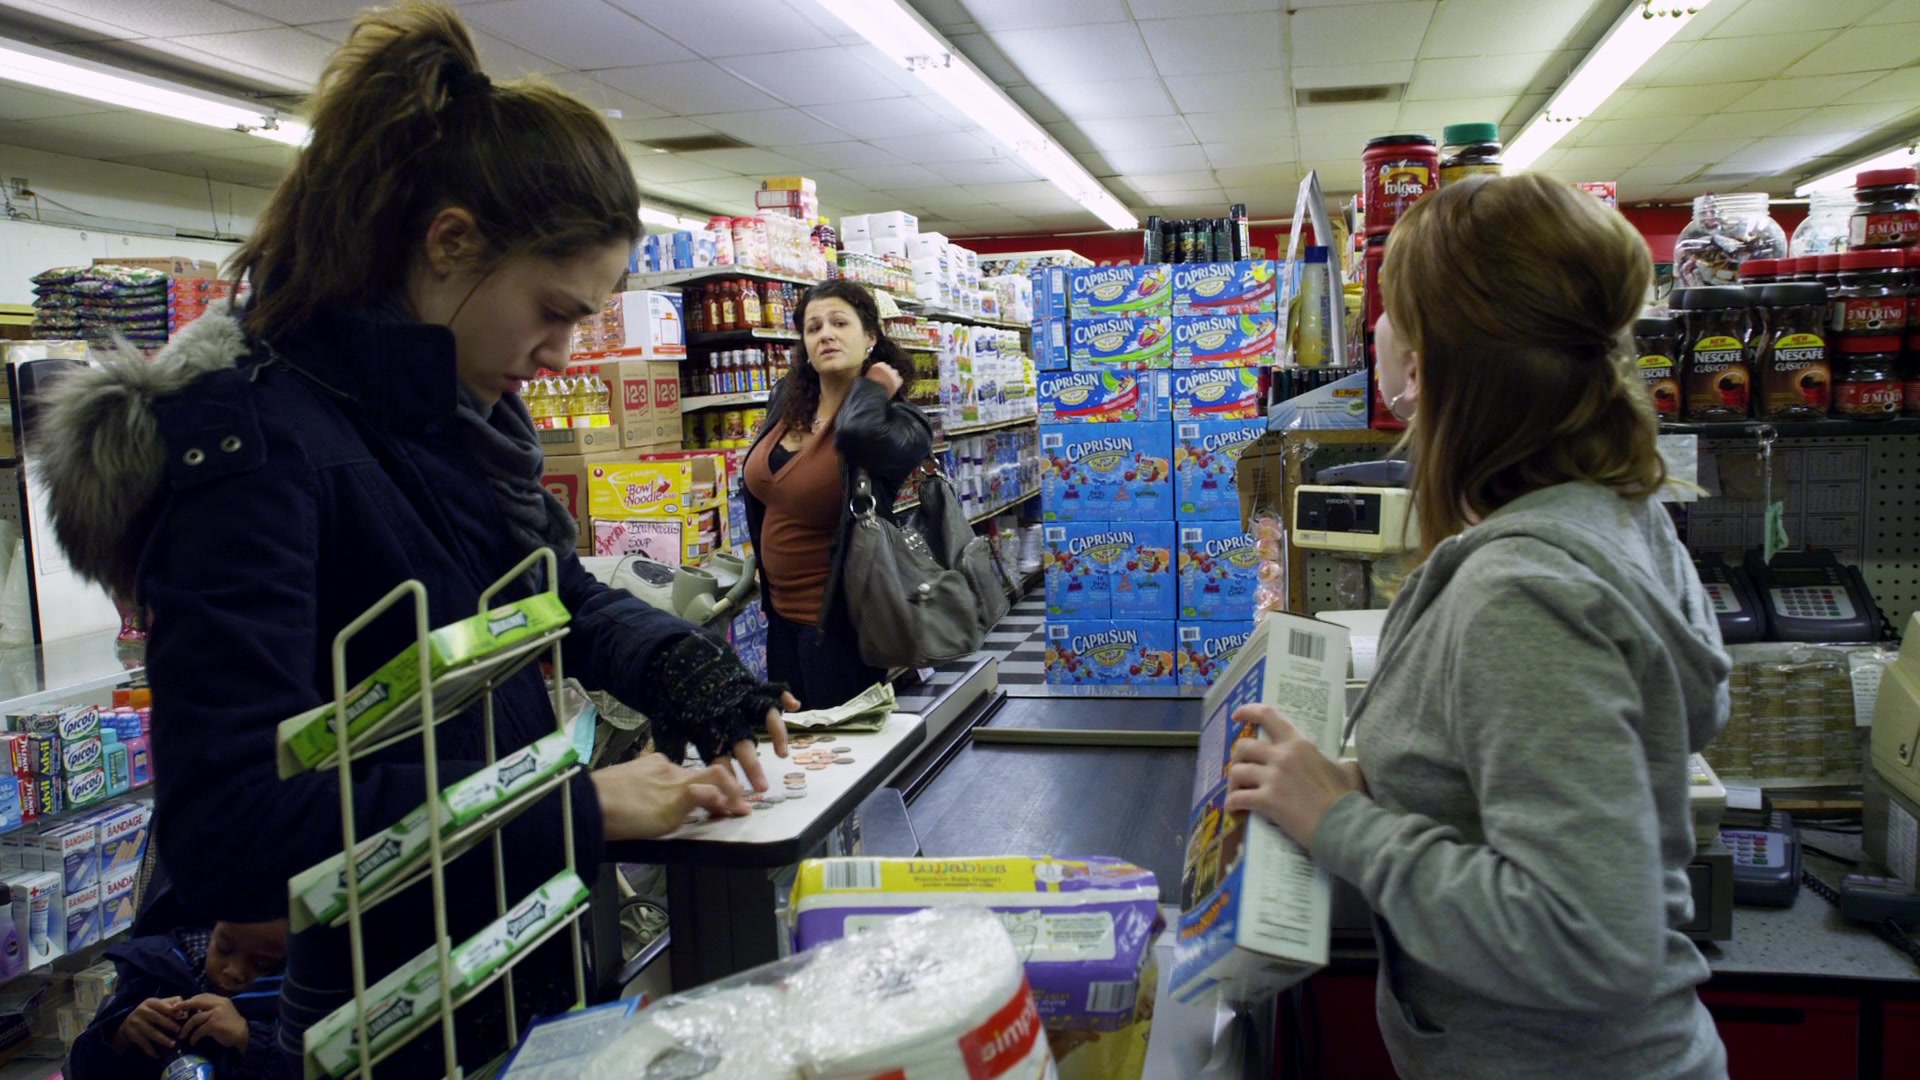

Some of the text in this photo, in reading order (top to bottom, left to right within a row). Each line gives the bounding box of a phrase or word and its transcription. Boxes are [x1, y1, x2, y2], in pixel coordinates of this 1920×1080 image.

[1384, 179, 1423, 197] Folgers
[1856, 309, 1902, 320] MARINO
[1694, 350, 1743, 363] NESCAFÉ
[1775, 348, 1825, 361] NESCAFÉ
[626, 480, 654, 495] Bowl
[624, 492, 662, 507] Noodle
[20, 740, 29, 772] TYLENOL
[40, 741, 50, 775] Advil
[26, 783, 34, 816] TYLENOL
[41, 780, 52, 814] Advil
[107, 814, 143, 836] BANDAGE
[64, 831, 94, 848] BANDAGE
[107, 875, 134, 895] BANDA
[68, 889, 98, 908] BANDAGE
